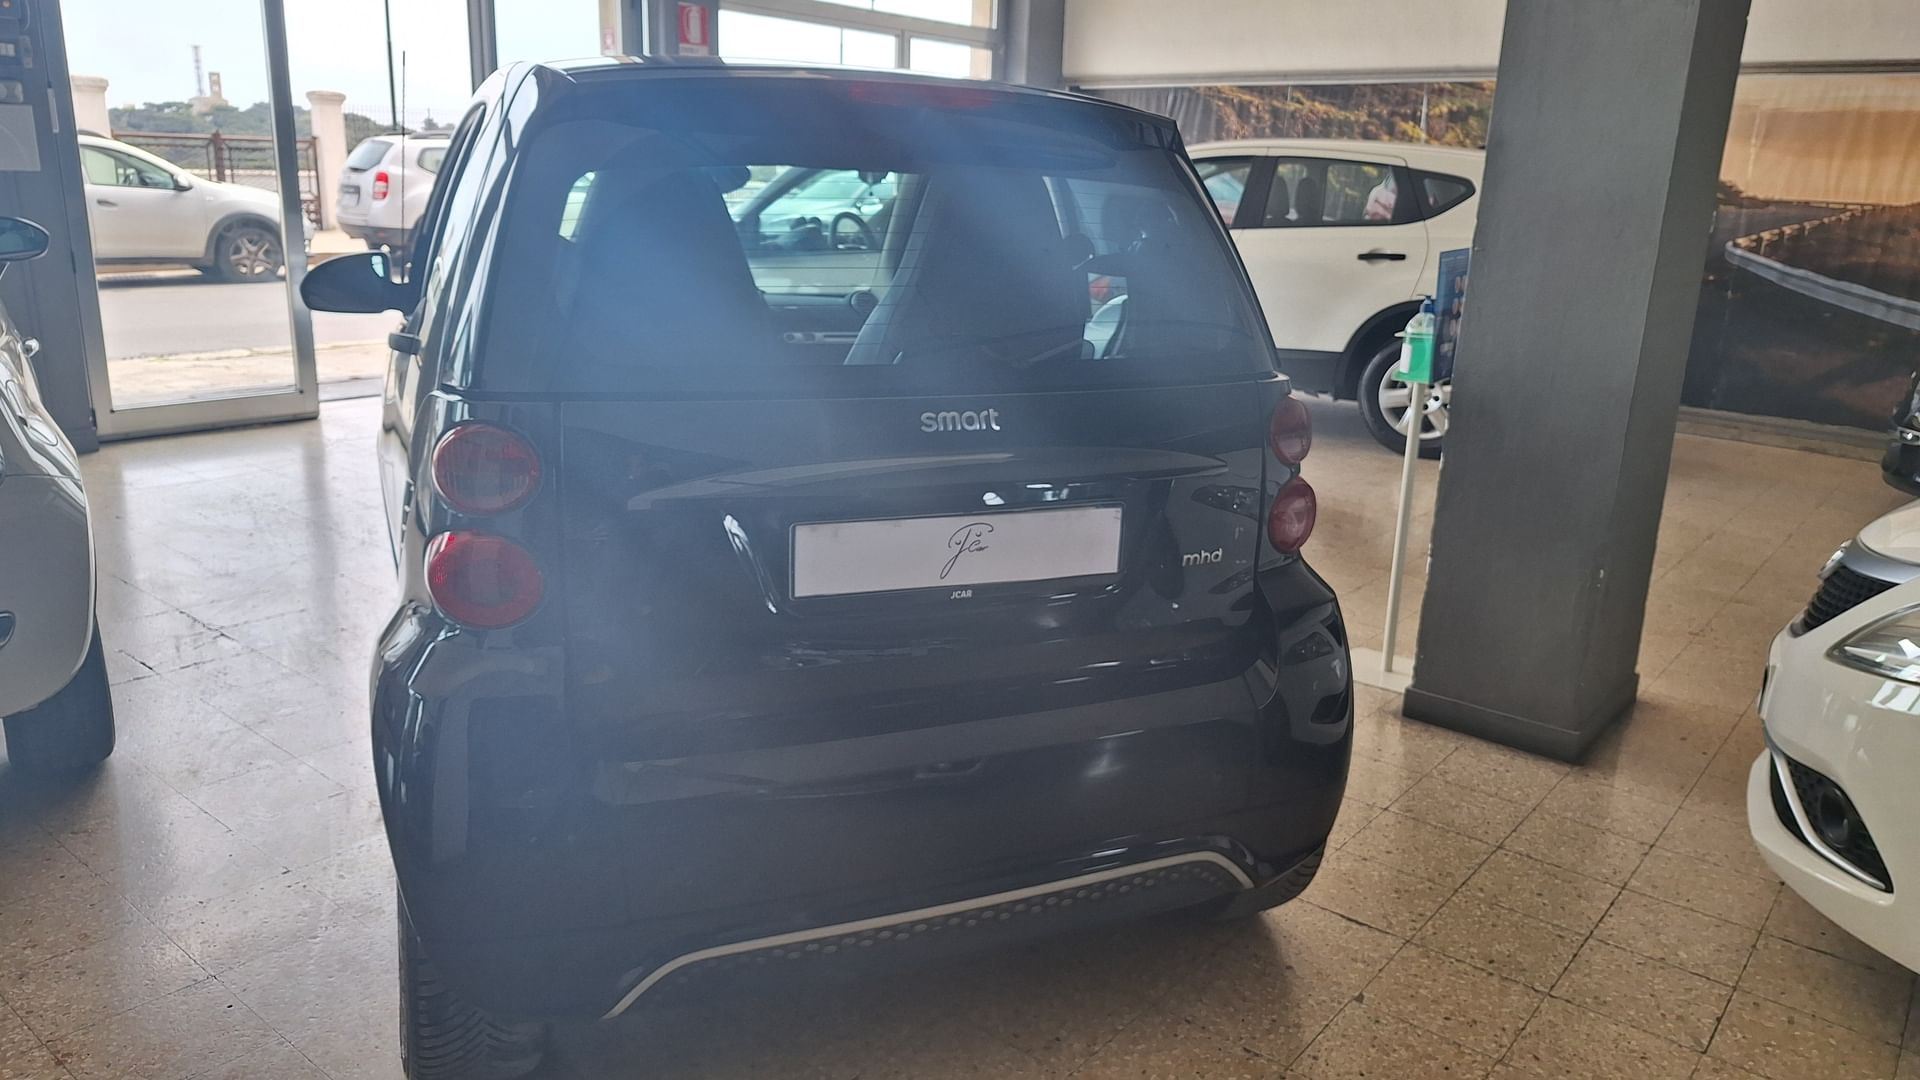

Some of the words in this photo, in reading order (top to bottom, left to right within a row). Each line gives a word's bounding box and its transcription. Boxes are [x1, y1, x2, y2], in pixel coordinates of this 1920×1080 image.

[920, 408, 1001, 432] smart
[1182, 547, 1223, 567] mhd
[950, 589, 973, 600] JCAR
